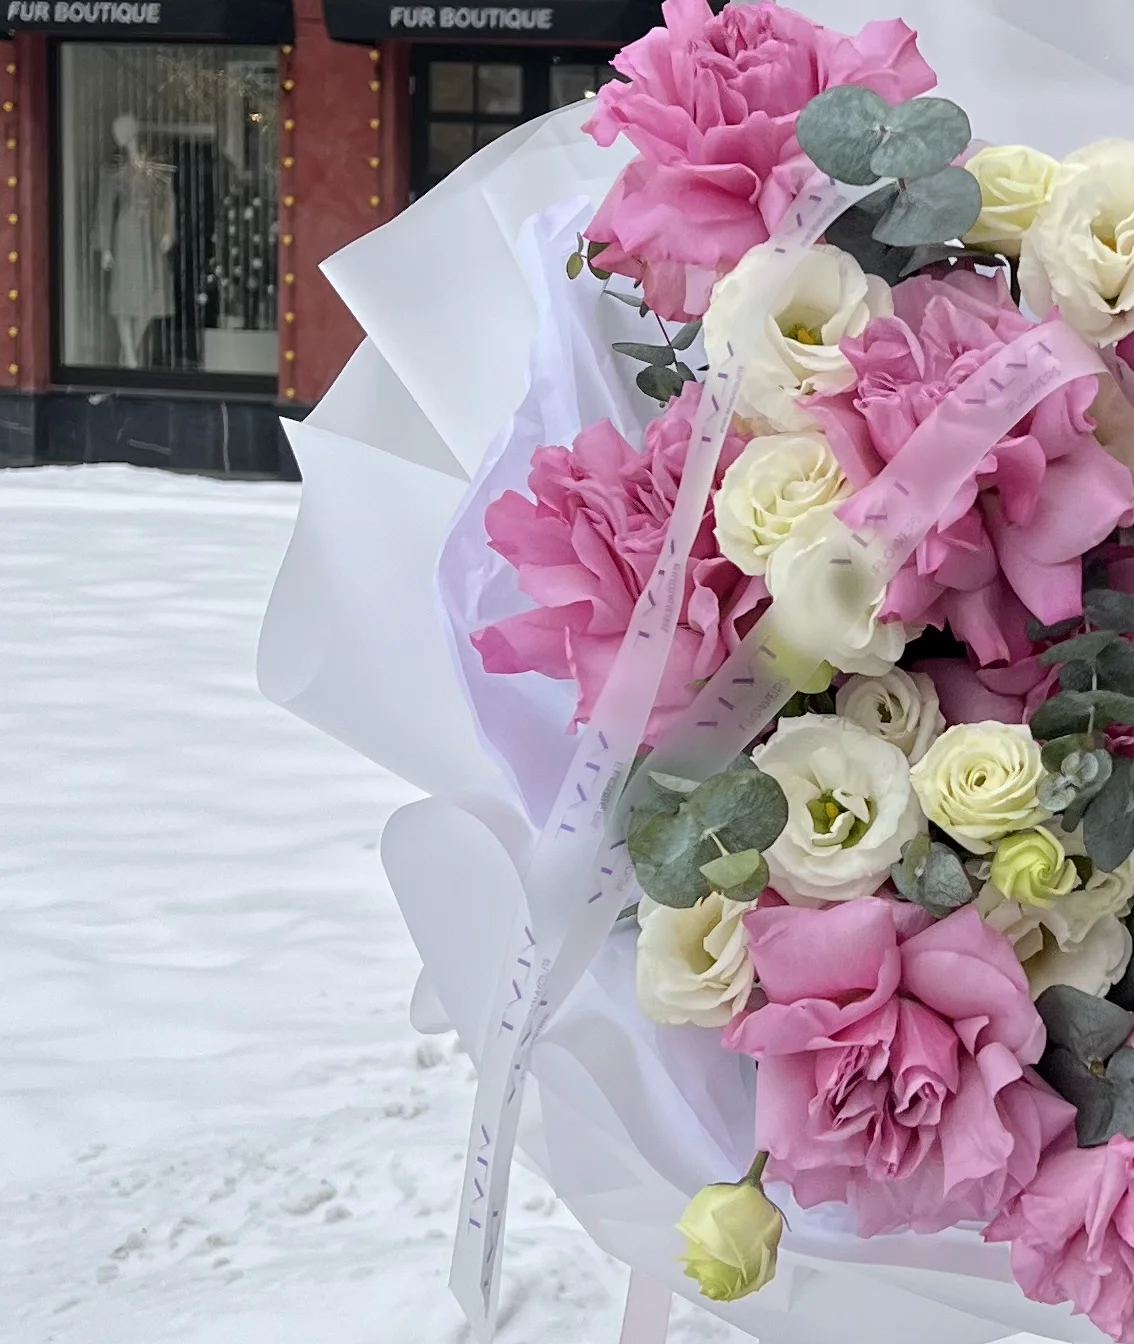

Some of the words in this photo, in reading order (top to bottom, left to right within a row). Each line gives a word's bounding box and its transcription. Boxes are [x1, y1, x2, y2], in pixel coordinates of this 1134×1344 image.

[7, 1, 50, 22] FUR
[54, 2, 162, 24] BOUTIQUE
[390, 6, 436, 28] FUR
[440, 7, 553, 29] BOUTIQUE
